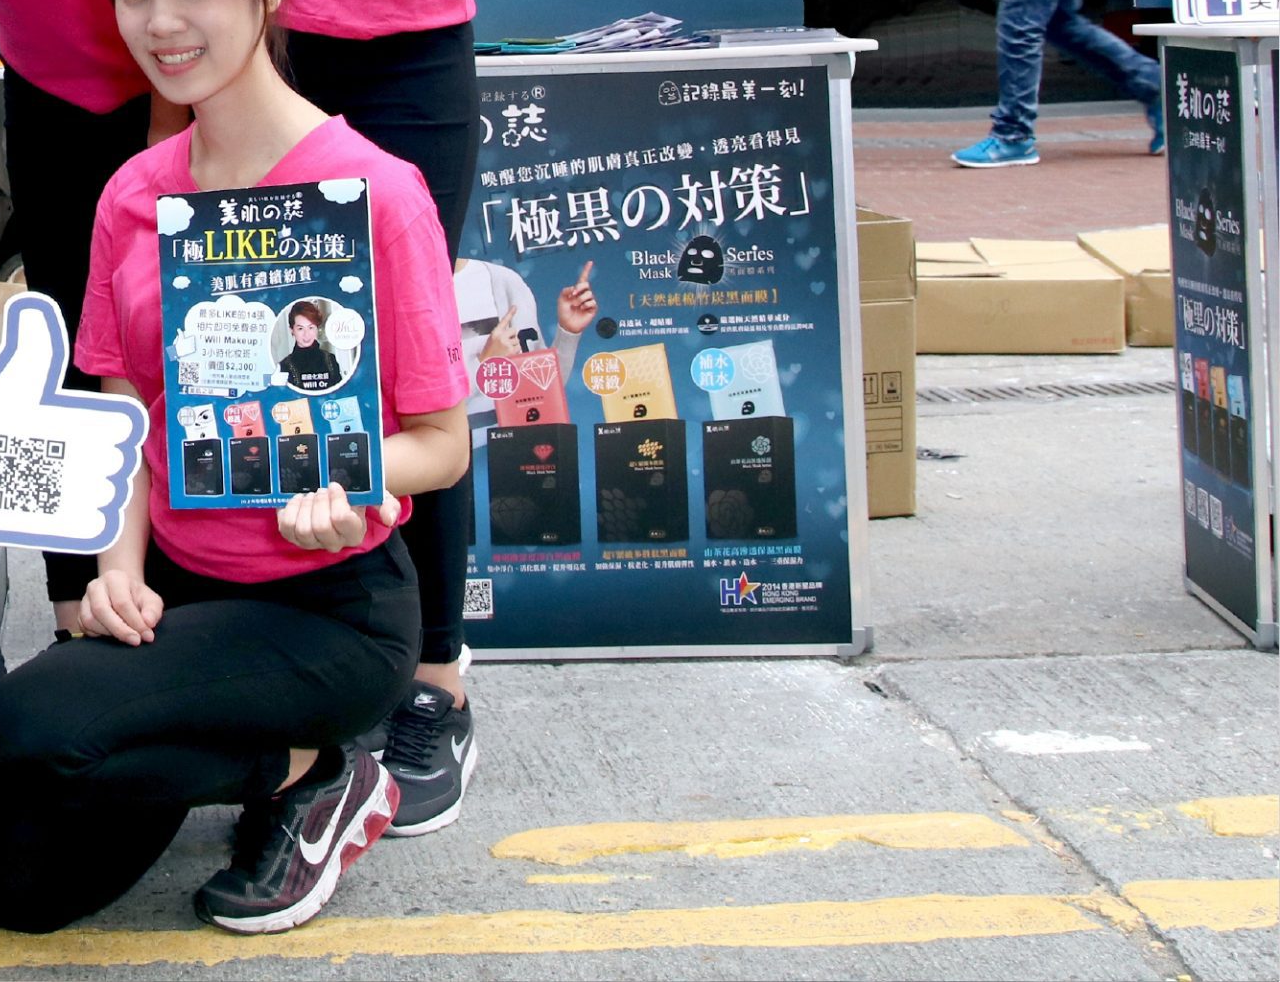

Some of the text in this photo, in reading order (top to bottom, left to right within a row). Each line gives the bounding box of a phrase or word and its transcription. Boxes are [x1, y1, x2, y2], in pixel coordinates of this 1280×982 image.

[219, 197, 305, 227] 美肌の誌
[631, 244, 775, 267] Black Series
[639, 268, 673, 280] Mask
